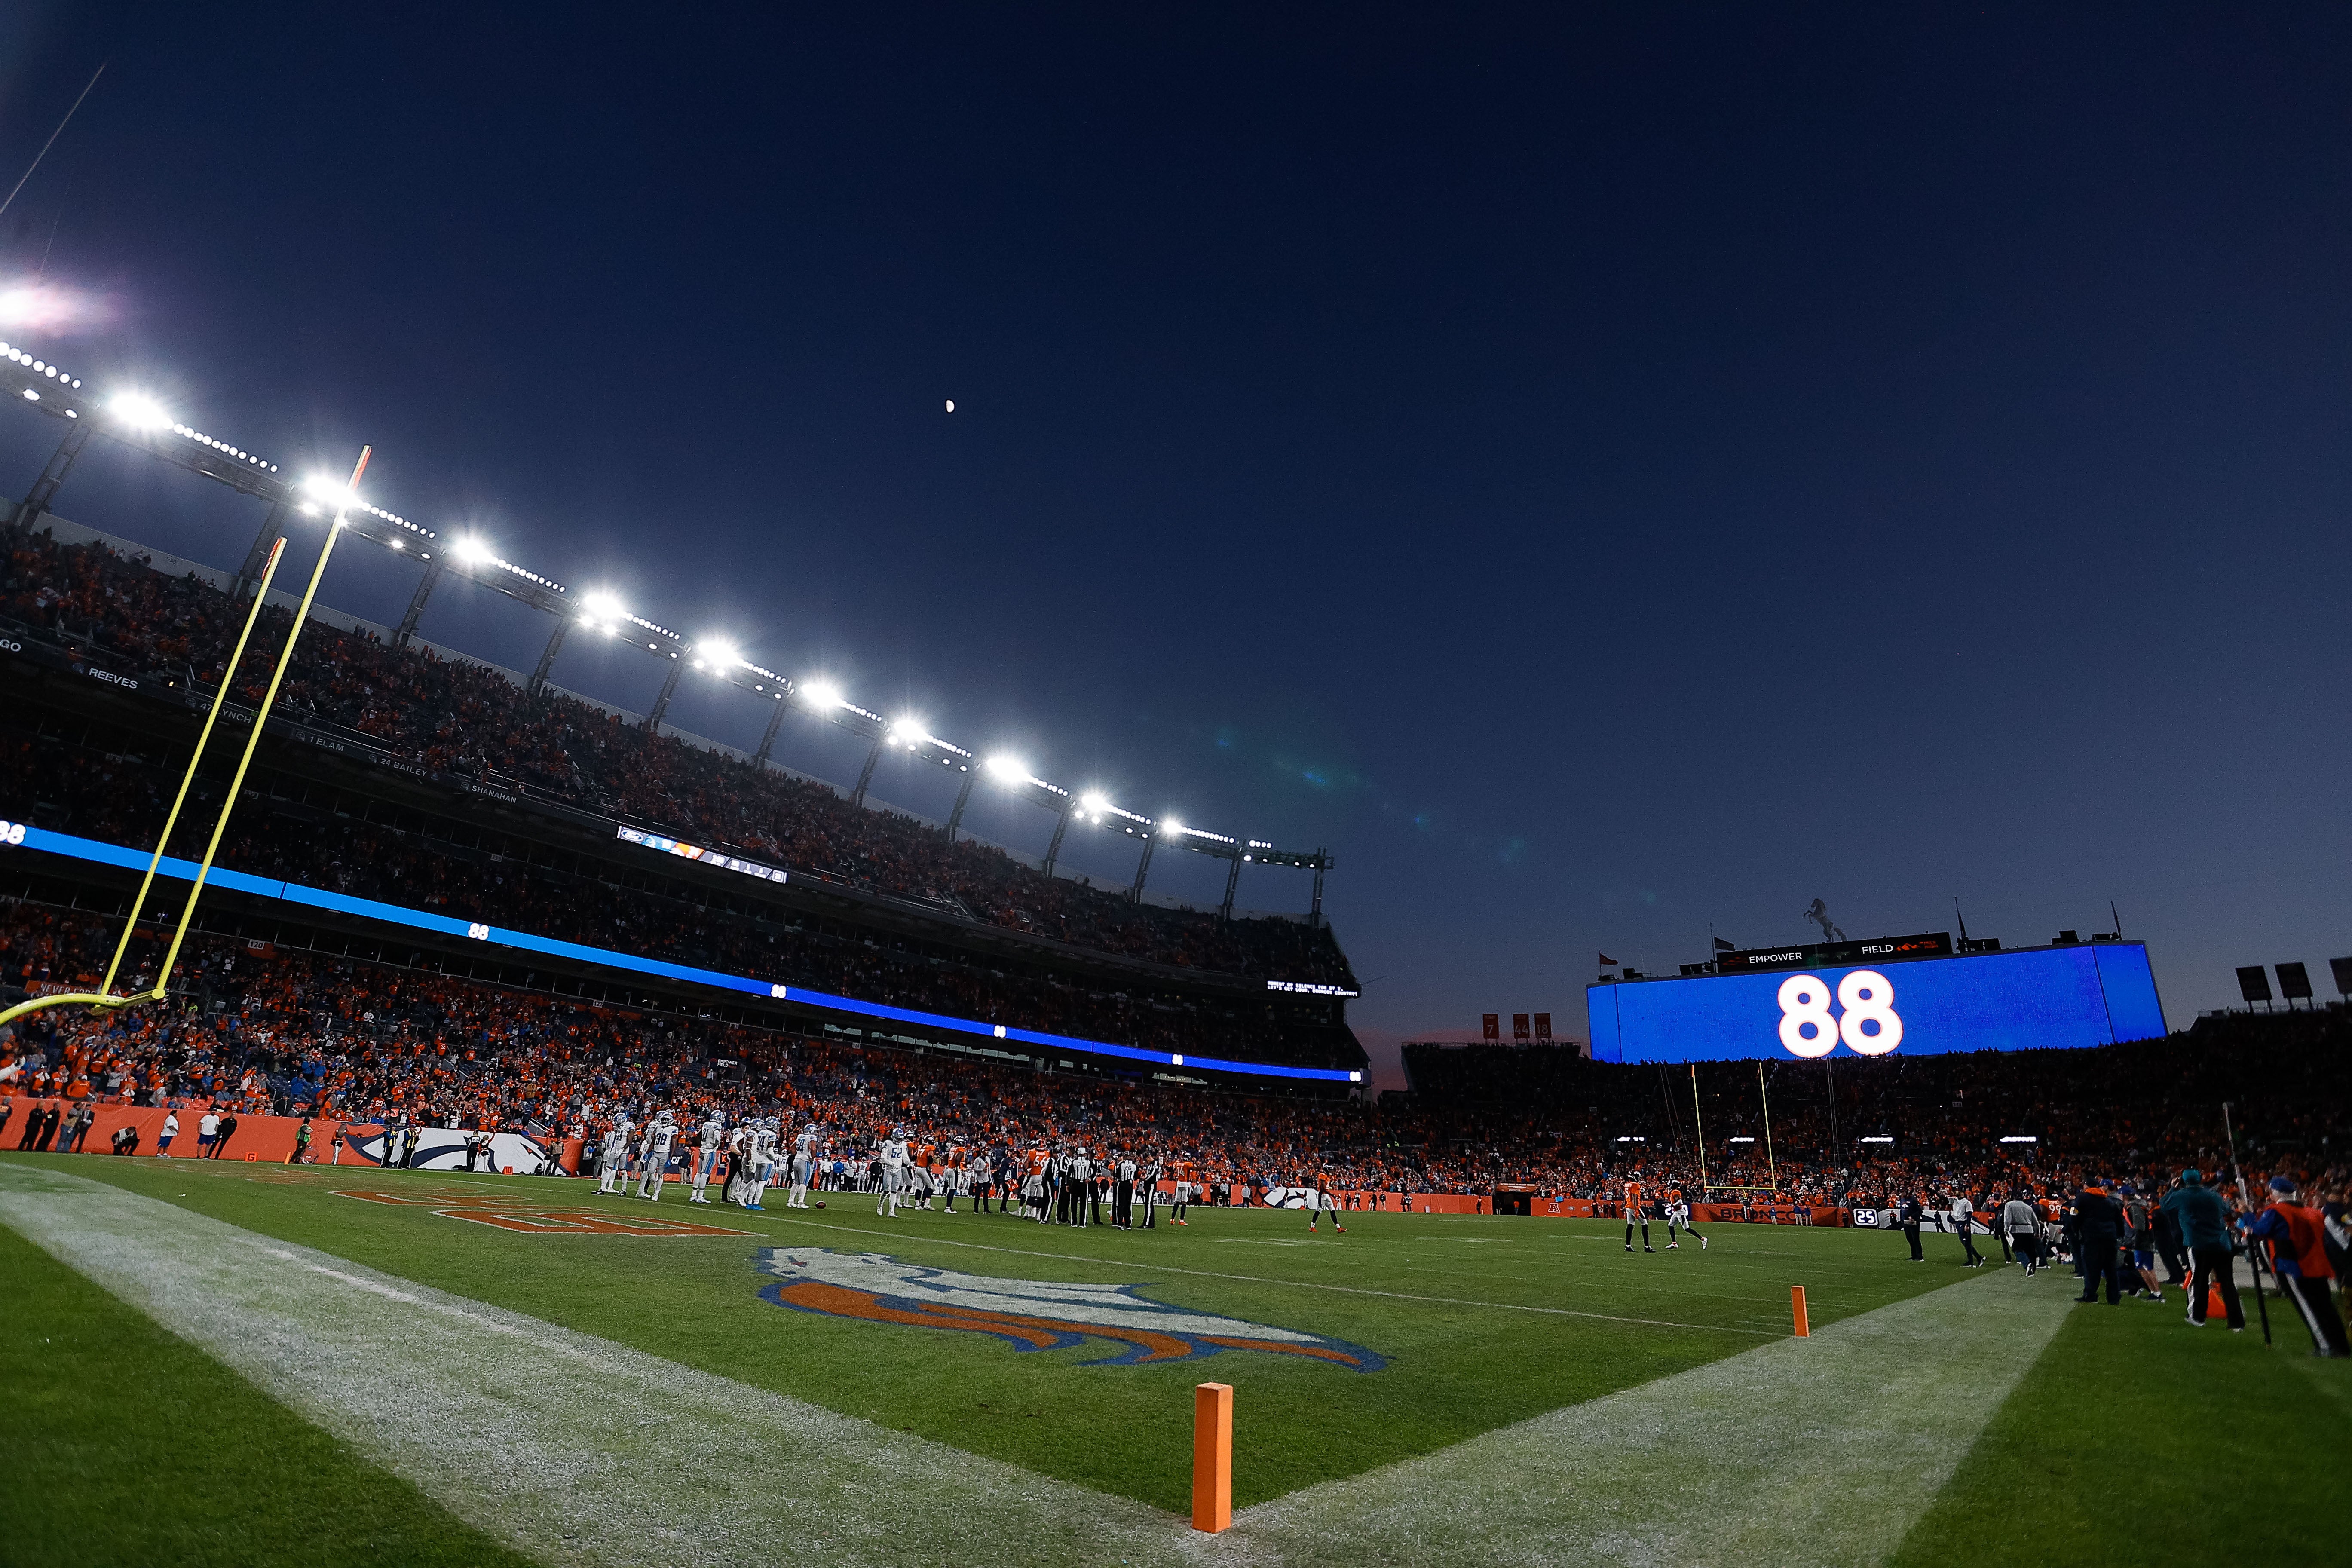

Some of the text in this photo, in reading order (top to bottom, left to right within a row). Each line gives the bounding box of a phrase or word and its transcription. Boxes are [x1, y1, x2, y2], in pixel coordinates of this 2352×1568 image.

[89, 668, 138, 689] REEVES
[200, 702, 251, 724] 47 YNCH
[316, 738, 344, 752] ELAM
[380, 758, 427, 777] 24 BAILEY
[472, 785, 517, 804] SHANAHAN
[468, 923, 490, 940] 88
[1749, 944, 1893, 964] EMPOWER FIELD
[771, 984, 786, 998] 88
[1777, 969, 1904, 1058] 88
[1488, 1024, 1494, 1035] 7
[1515, 1024, 1528, 1035] 44
[1537, 1024, 1548, 1035] 18
[655, 1133, 668, 1145] 38
[248, 1153, 255, 1161] G
[891, 1148, 902, 1158] 52
[2049, 1204, 2061, 1215] 99
[1857, 1210, 1877, 1224] 25
